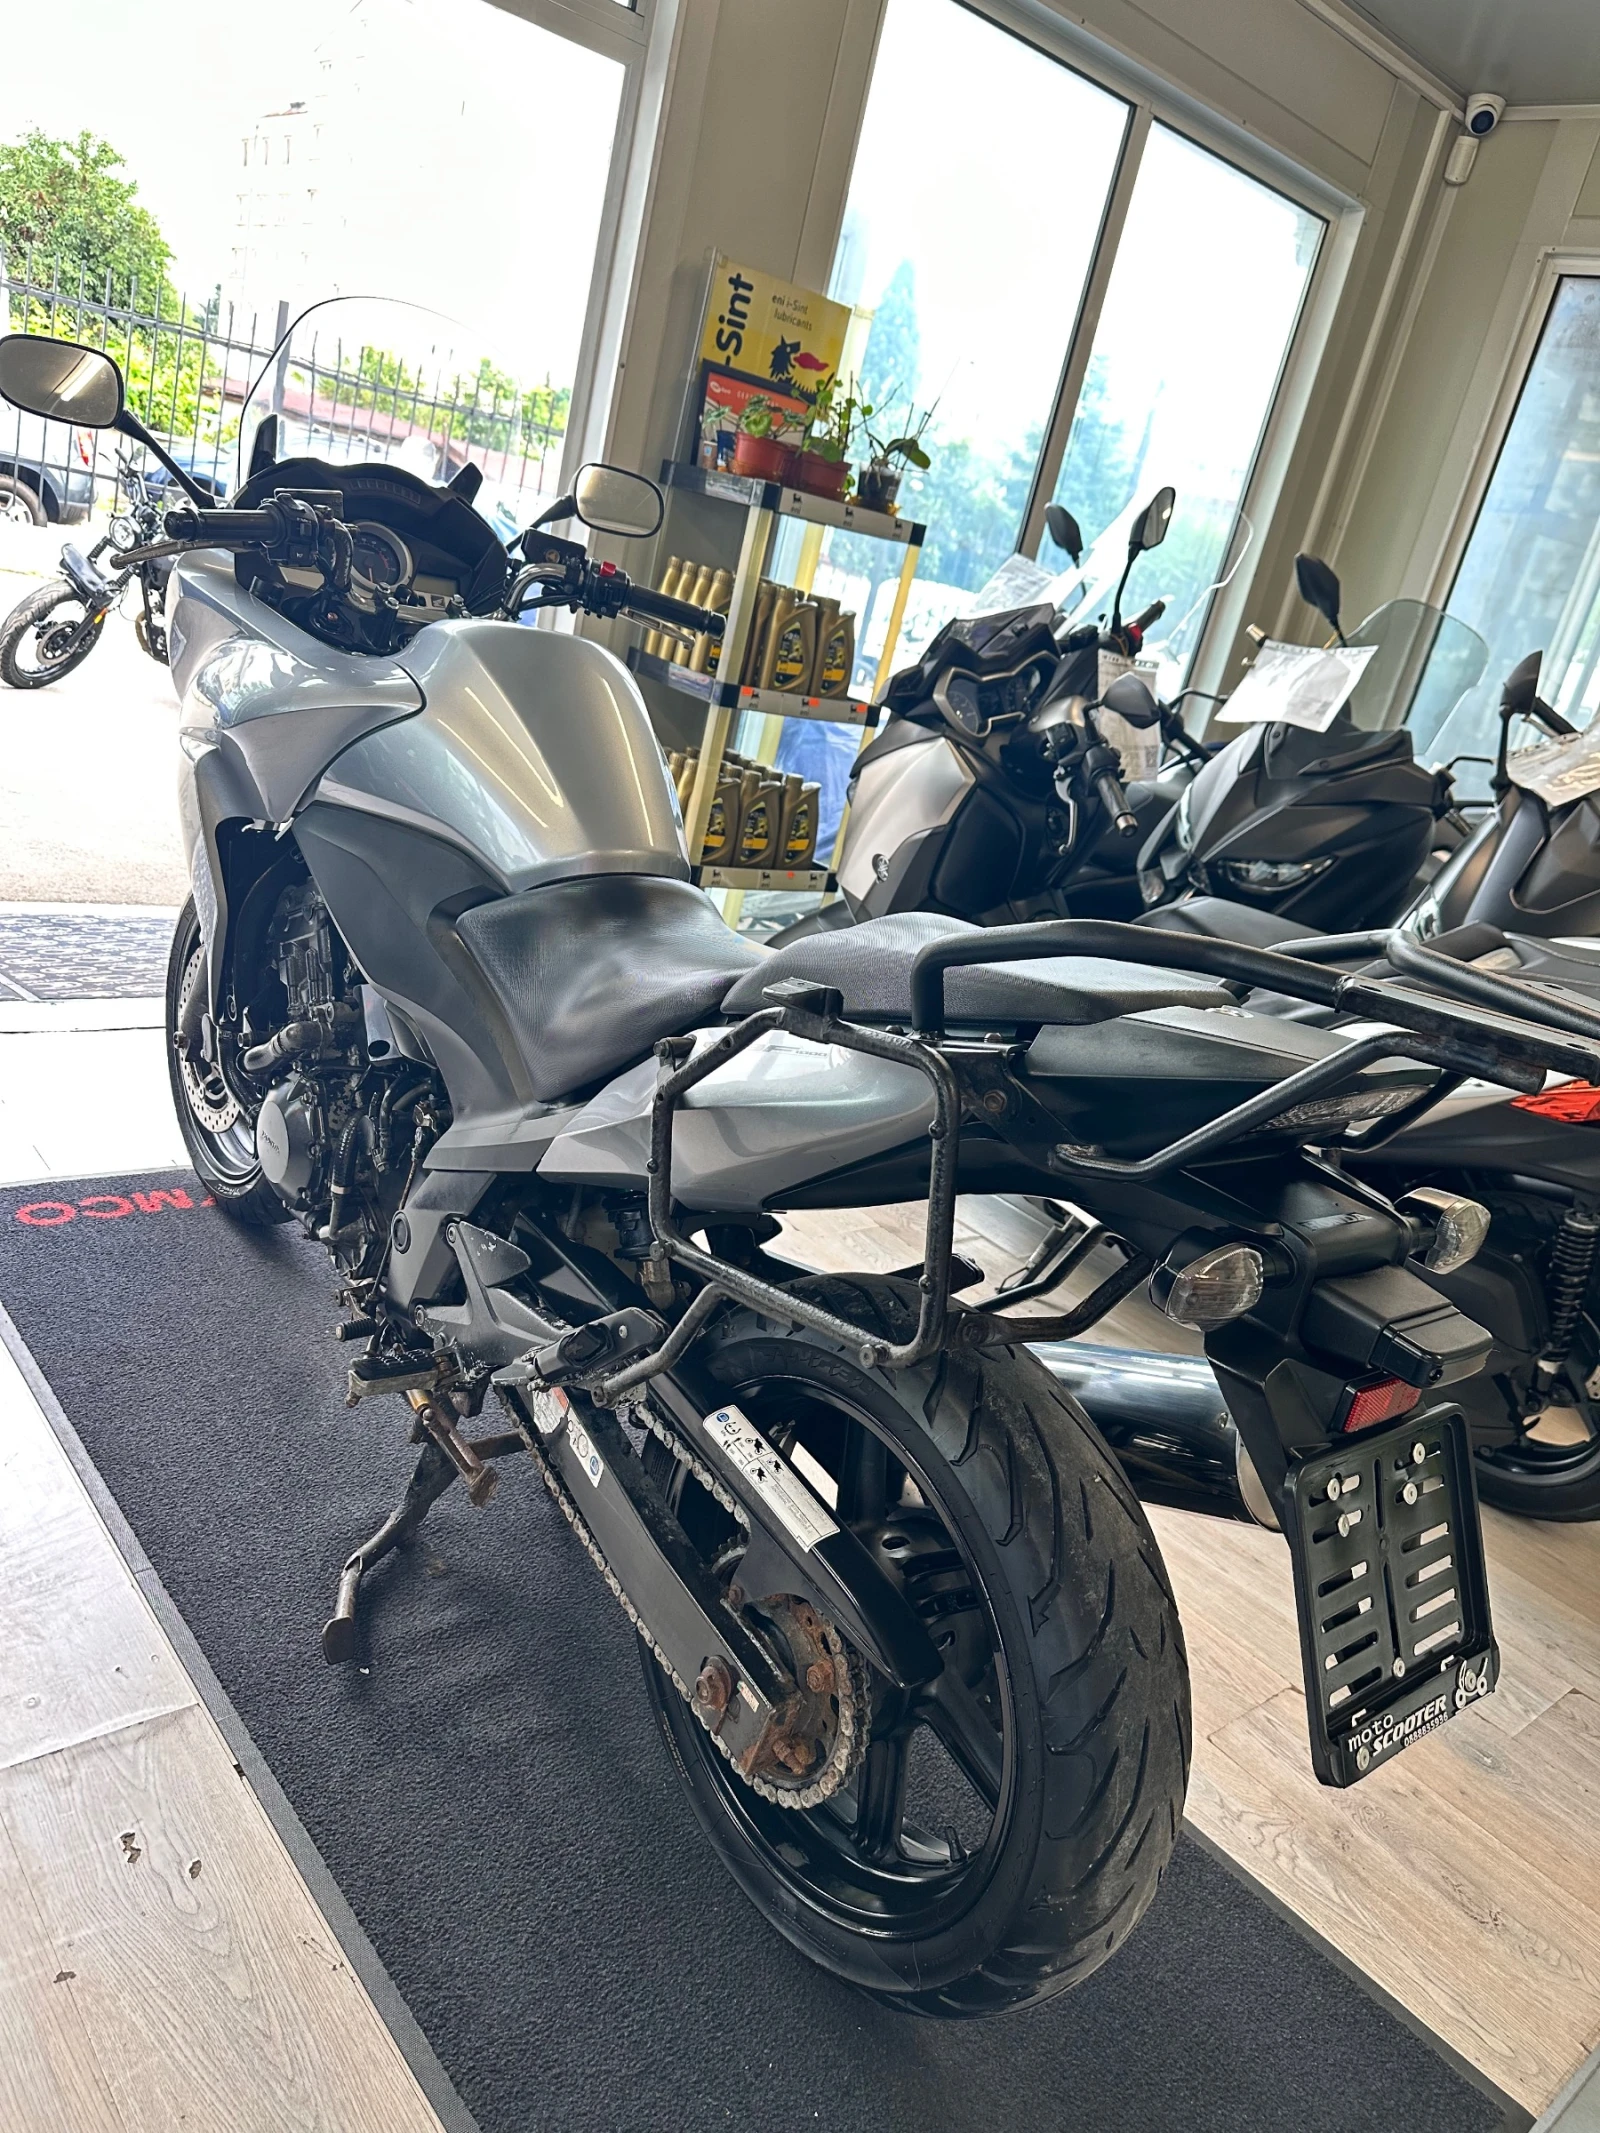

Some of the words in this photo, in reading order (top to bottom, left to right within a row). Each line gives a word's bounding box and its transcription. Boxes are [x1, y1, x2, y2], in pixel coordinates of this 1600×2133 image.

[772, 295, 785, 306] eni
[774, 308, 812, 331] lubricants
[1348, 1714, 1394, 1753] moto
[1373, 1694, 1447, 1757] SCOOTER
[1403, 1711, 1449, 1747] 0888835936
